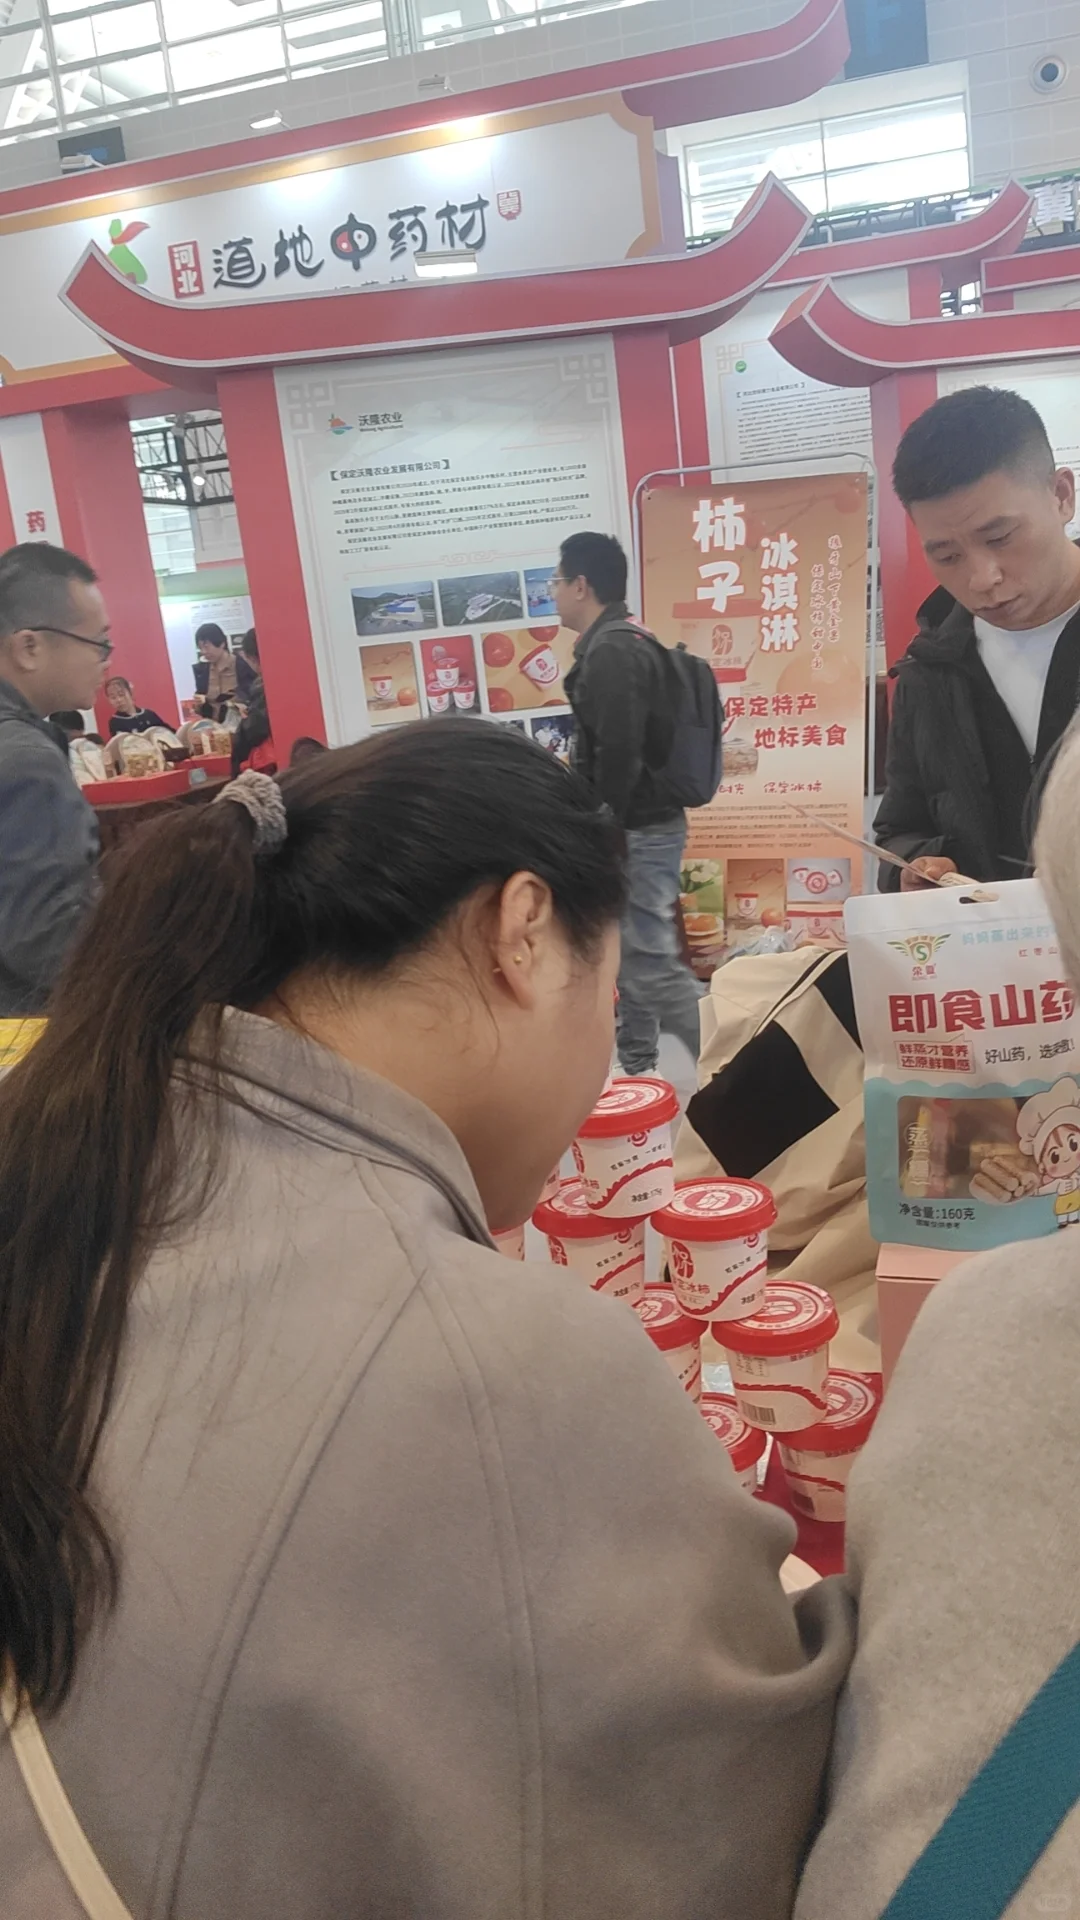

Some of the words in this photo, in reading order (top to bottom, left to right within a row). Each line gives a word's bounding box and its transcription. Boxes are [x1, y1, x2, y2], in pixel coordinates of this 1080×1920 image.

[211, 194, 490, 290] 道地中药材
[172, 243, 201, 296] 河北
[358, 412, 403, 427] 沃隆农业
[692, 497, 746, 613] 柿子
[760, 532, 800, 651] 冰淇淋
[724, 693, 817, 718] 保定特产
[754, 724, 848, 749] 地标美食
[888, 979, 1076, 1034] 即食山药
